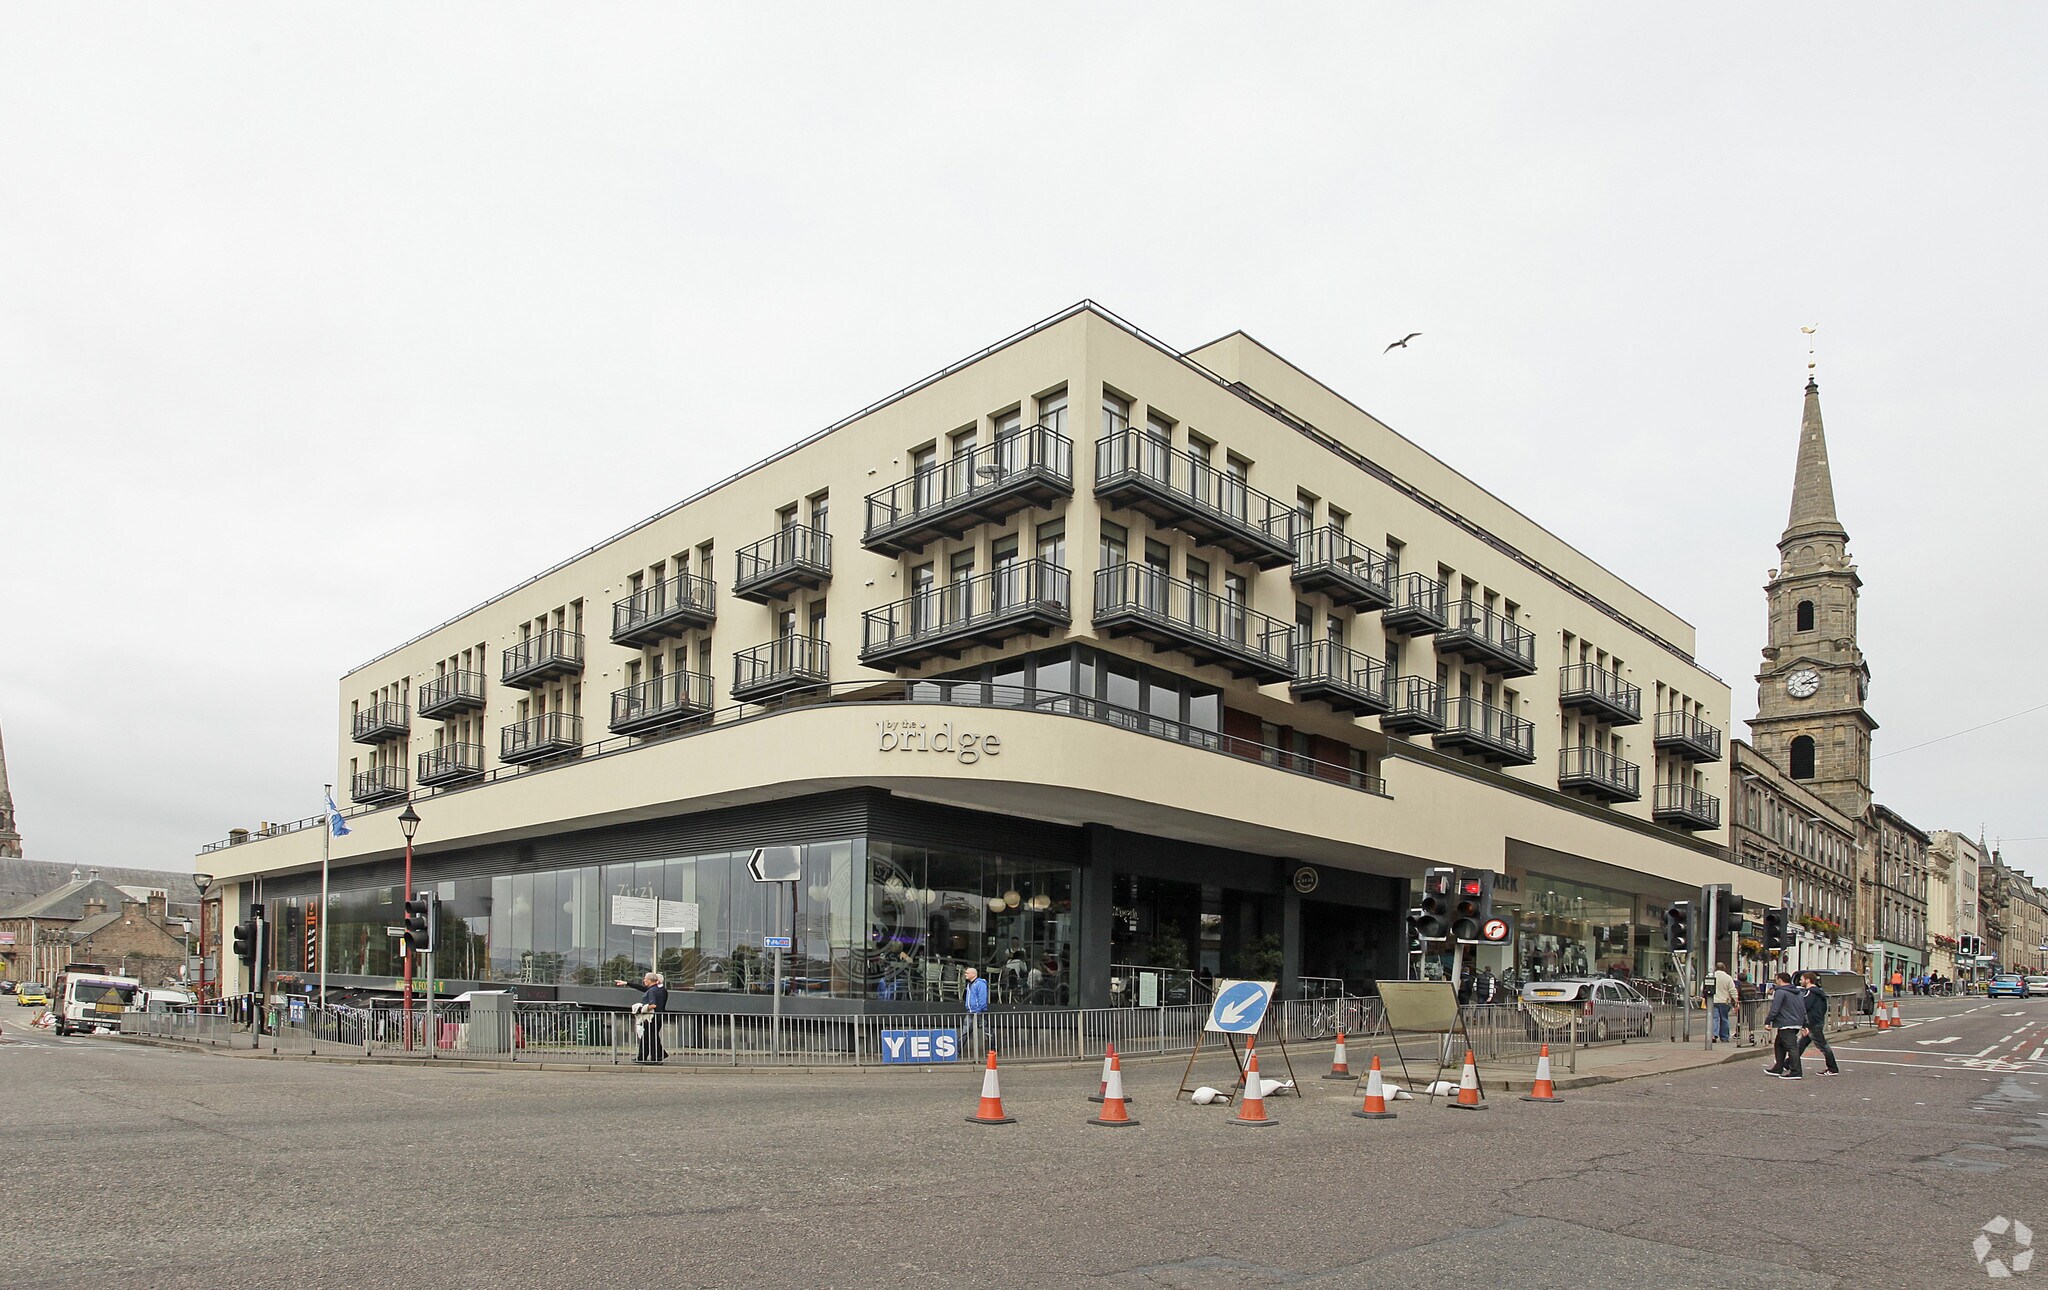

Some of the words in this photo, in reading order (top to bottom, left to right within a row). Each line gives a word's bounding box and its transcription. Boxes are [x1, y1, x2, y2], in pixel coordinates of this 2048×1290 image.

[886, 720, 898, 731] by
[901, 720, 917, 729] the
[876, 721, 1001, 764] bridge
[883, 1035, 956, 1058] YES
